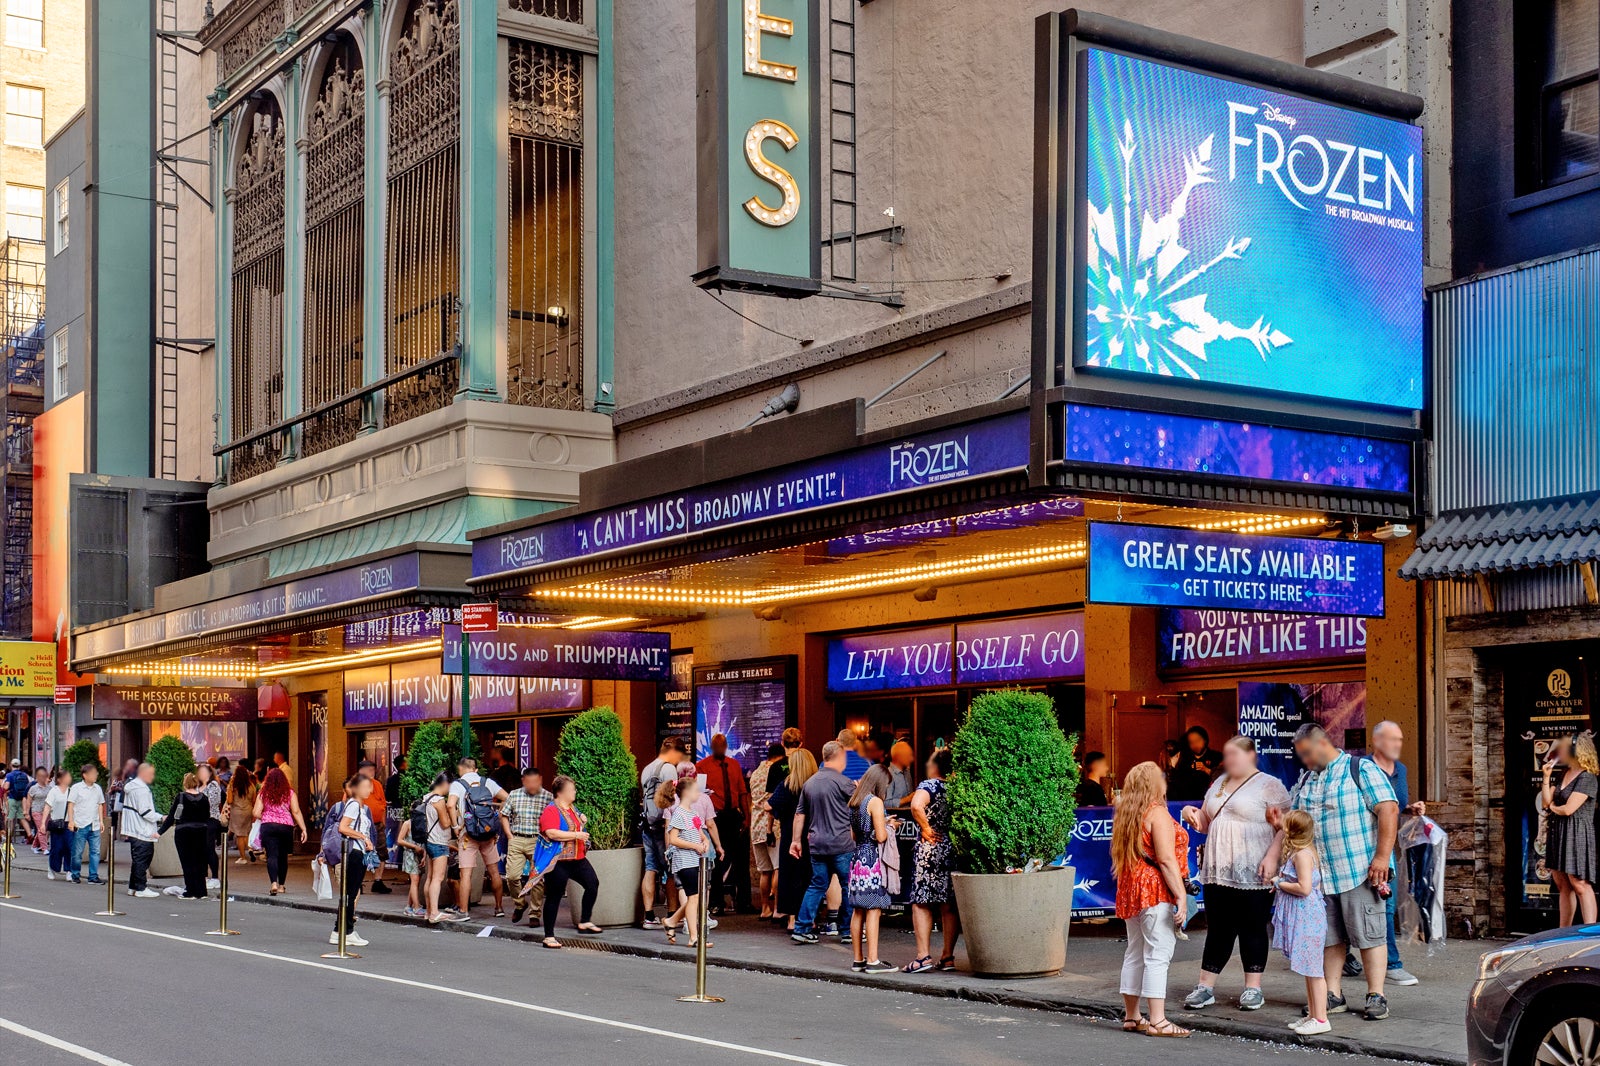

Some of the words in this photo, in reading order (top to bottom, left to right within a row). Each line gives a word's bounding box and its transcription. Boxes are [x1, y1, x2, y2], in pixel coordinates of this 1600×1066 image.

[1262, 102, 1297, 131] Disney
[1226, 100, 1414, 217] FROZEN
[1325, 204, 1338, 216] THE
[1339, 207, 1351, 219] HIT
[1352, 209, 1386, 226] BROADWAY
[1387, 218, 1414, 231] MUSICAL
[890, 434, 968, 485] FROZEN
[594, 497, 686, 546] CAN'T-MISS
[695, 486, 772, 524] BROADWAY
[777, 472, 836, 507] EVENT!"
[500, 532, 544, 567] FROZEN
[1123, 540, 1188, 571] GREAT
[1194, 544, 1252, 576] SEATS
[1258, 549, 1356, 583] AVAILABLE
[360, 564, 393, 594] FROZEN
[1183, 578, 1208, 597] GET
[1213, 579, 1266, 601] TICKETS
[1270, 584, 1303, 603] HERE
[131, 618, 165, 644] BRILLIANT
[167, 613, 209, 636] SPECTACLE,
[210, 615, 217, 627] AS
[218, 604, 261, 627] JAW-DROPPING
[263, 599, 270, 614] AS
[271, 597, 278, 612] IT
[279, 595, 286, 611] IS
[464, 613, 482, 621] Anytime
[1171, 628, 1253, 662] FROZEN
[1260, 621, 1307, 654] LIKE
[1315, 617, 1366, 649] THIS
[523, 648, 549, 662] AND
[554, 645, 668, 666] TRIUMPHANT."
[844, 648, 894, 681] LET
[900, 633, 1035, 677] YOURSELF
[1041, 629, 1079, 665] GO
[6, 676, 25, 687] Me
[706, 672, 717, 681] ST.
[718, 670, 739, 680] JAMES
[741, 667, 773, 678] THEATRE
[116, 690, 141, 702] "THE
[143, 691, 187, 703] MESSAGE
[189, 692, 197, 702] IS
[199, 692, 232, 703] CLEAR:
[367, 676, 420, 709] HOTTEST
[1561, 699, 1583, 707] RIVER
[140, 702, 173, 715] LOVE
[179, 703, 217, 716] WINS!"
[1240, 705, 1285, 720] AMAZING
[1286, 713, 1301, 723] special
[387, 805, 405, 821] FROZE
[1068, 819, 1113, 842] ROZE
